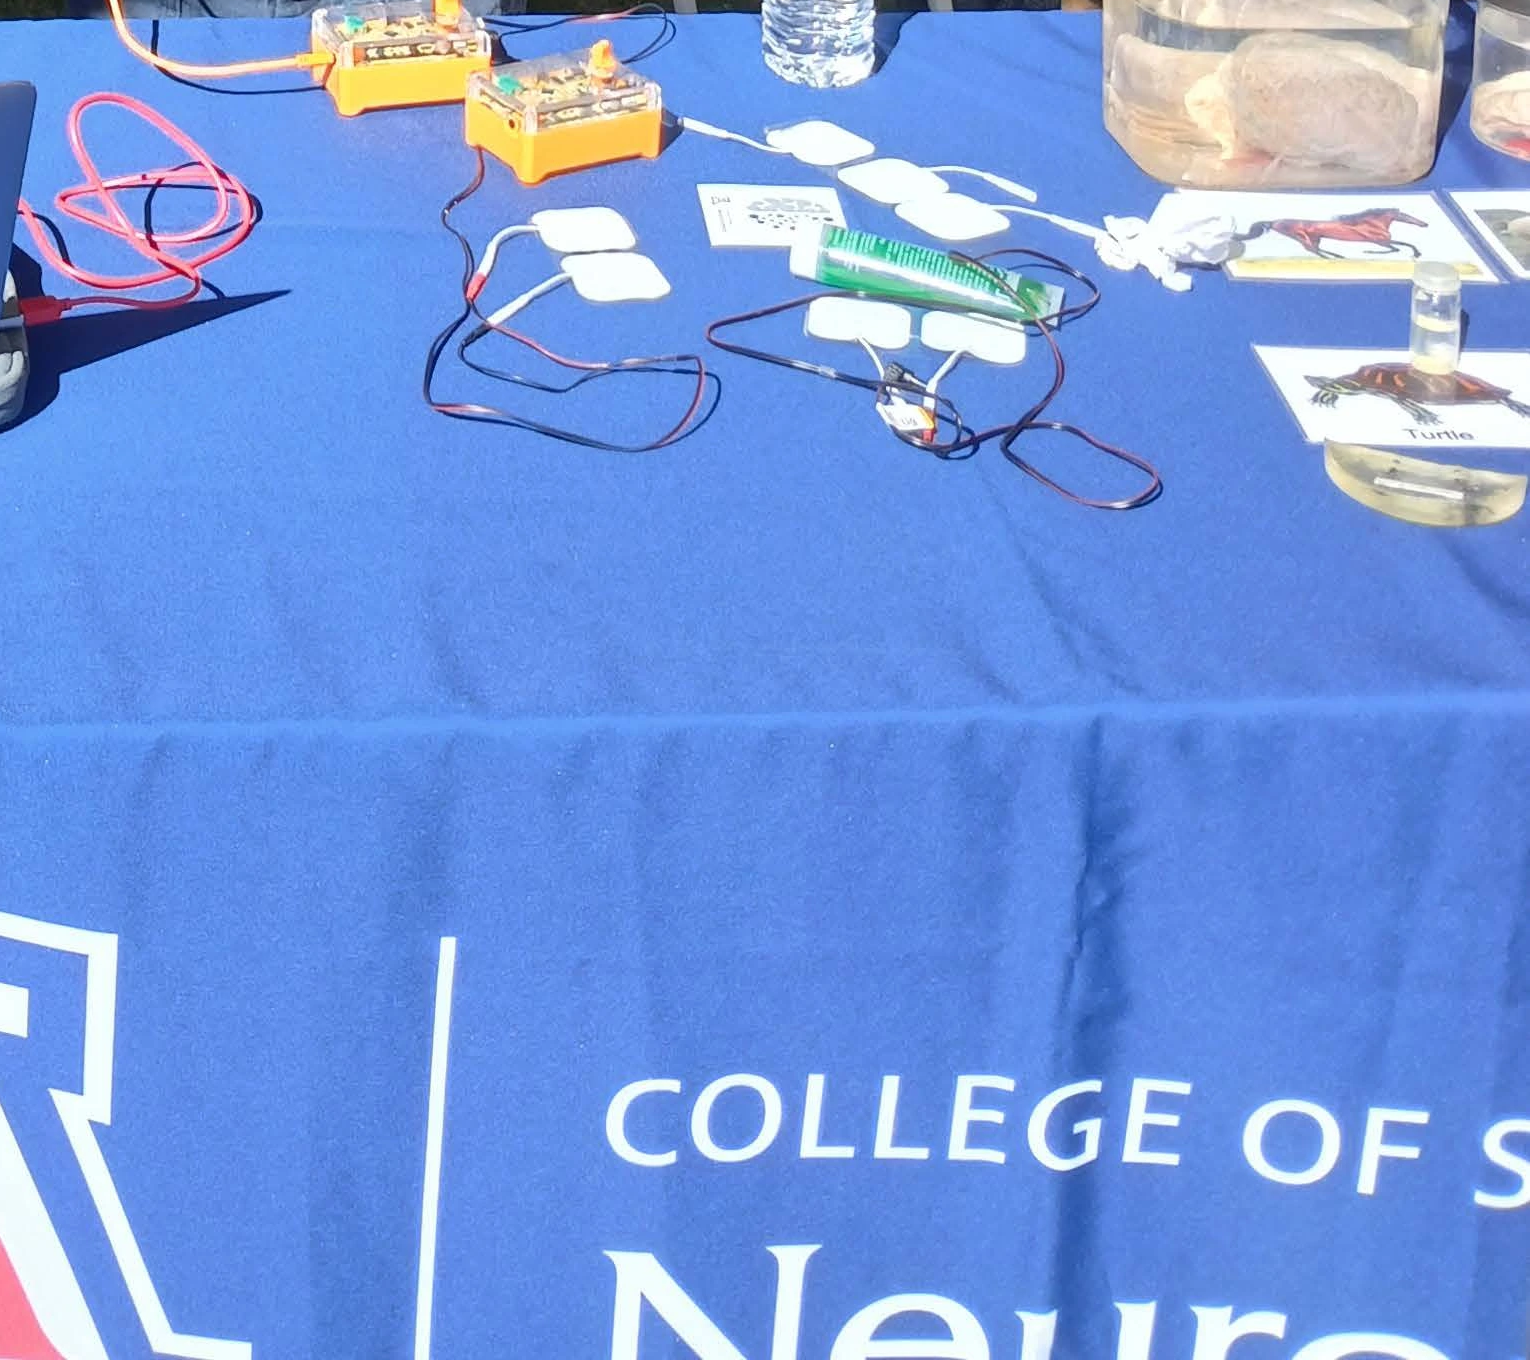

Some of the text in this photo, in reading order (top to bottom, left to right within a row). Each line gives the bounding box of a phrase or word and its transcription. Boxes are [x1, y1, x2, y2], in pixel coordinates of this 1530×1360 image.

[1402, 427, 1475, 441] Turtle
[605, 1071, 1193, 1171] COLLEGE
[1241, 1099, 1431, 1196] OF
[601, 1243, 1454, 1360] Neur
